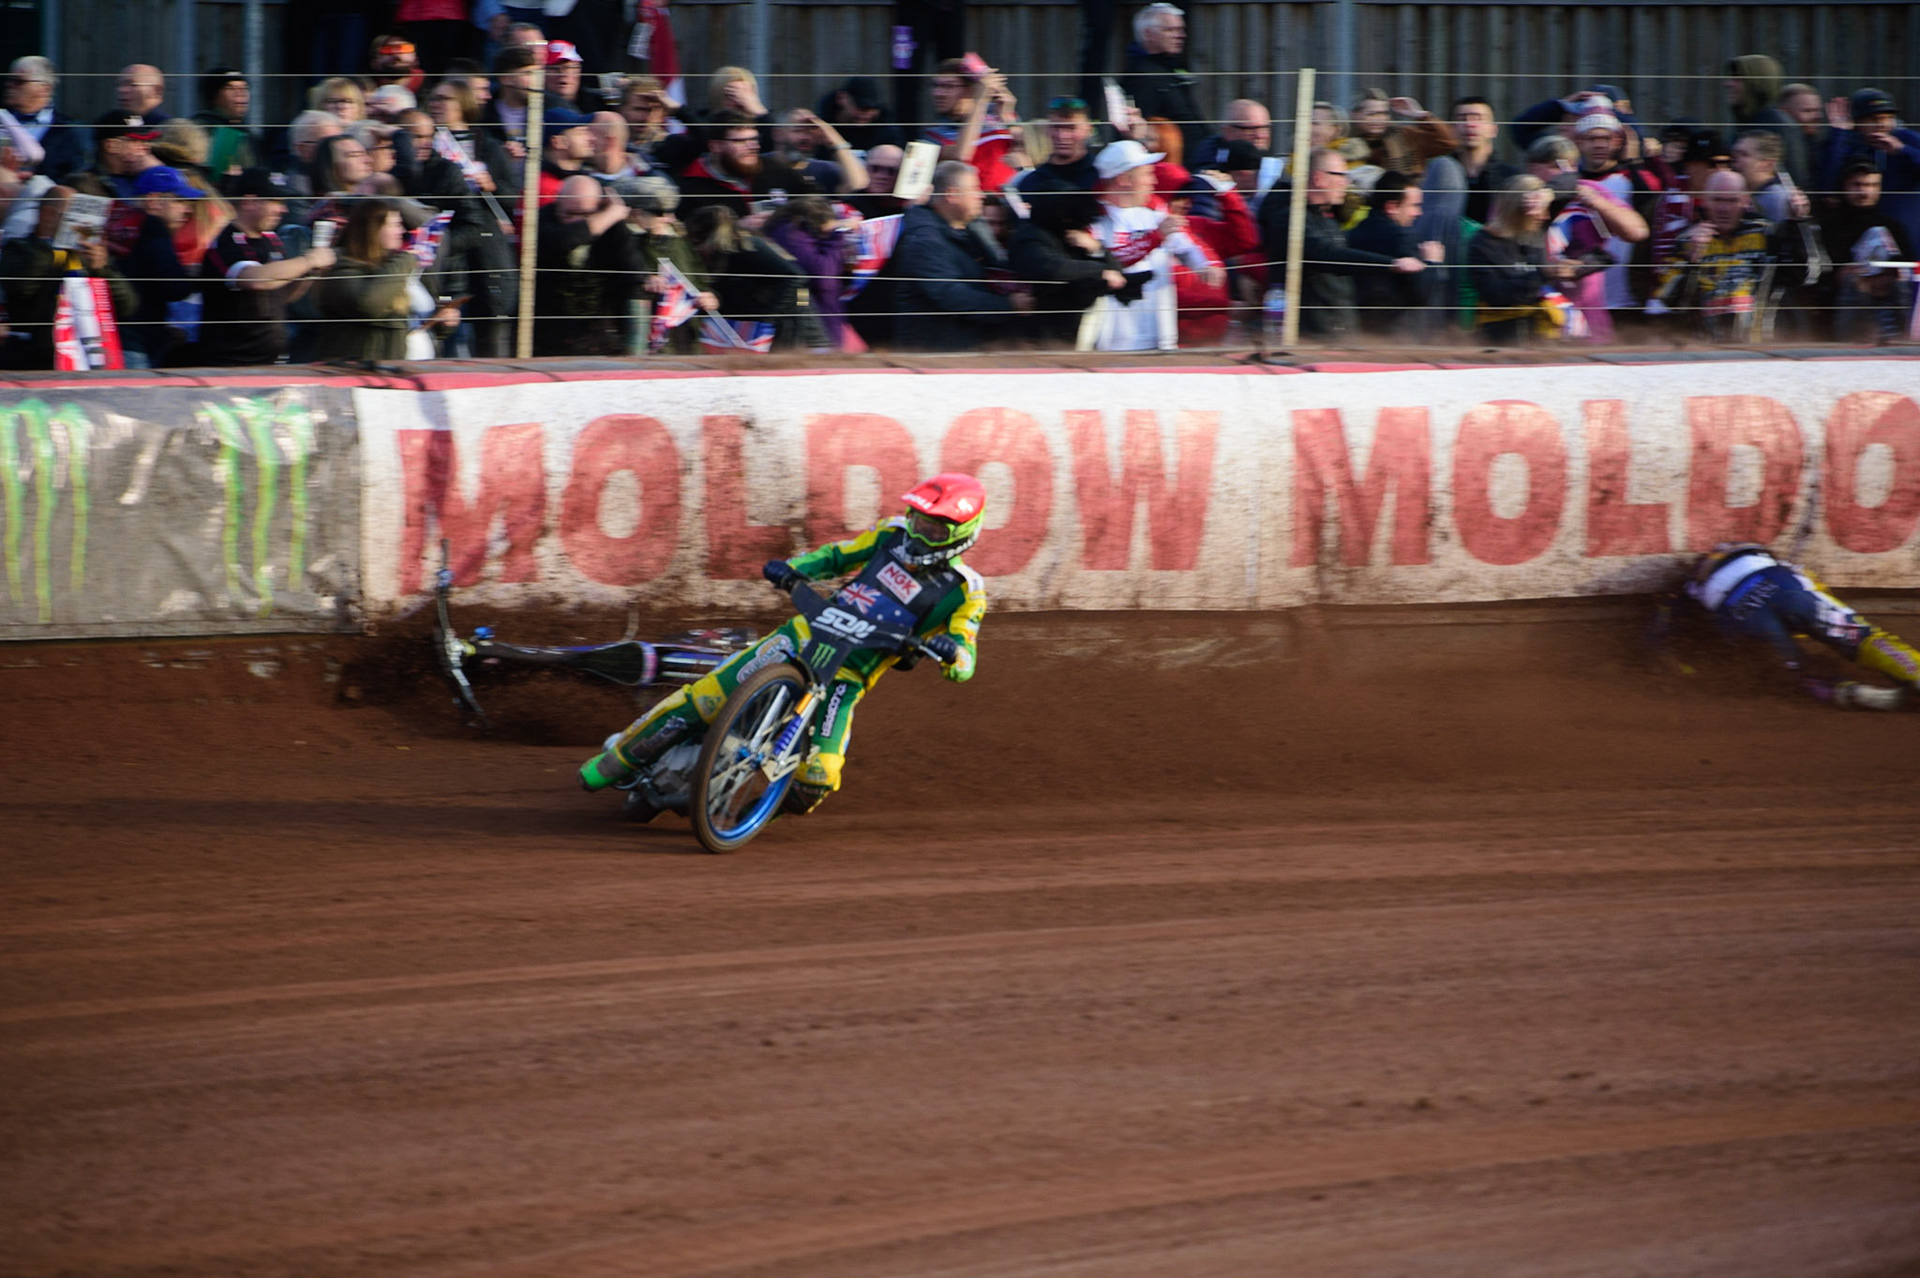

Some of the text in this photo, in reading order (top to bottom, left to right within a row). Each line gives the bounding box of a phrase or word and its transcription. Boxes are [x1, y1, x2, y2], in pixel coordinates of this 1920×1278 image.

[395, 391, 1920, 597] MOLDOW MOLDO
[885, 565, 917, 596] NGK
[815, 606, 877, 639] SON
